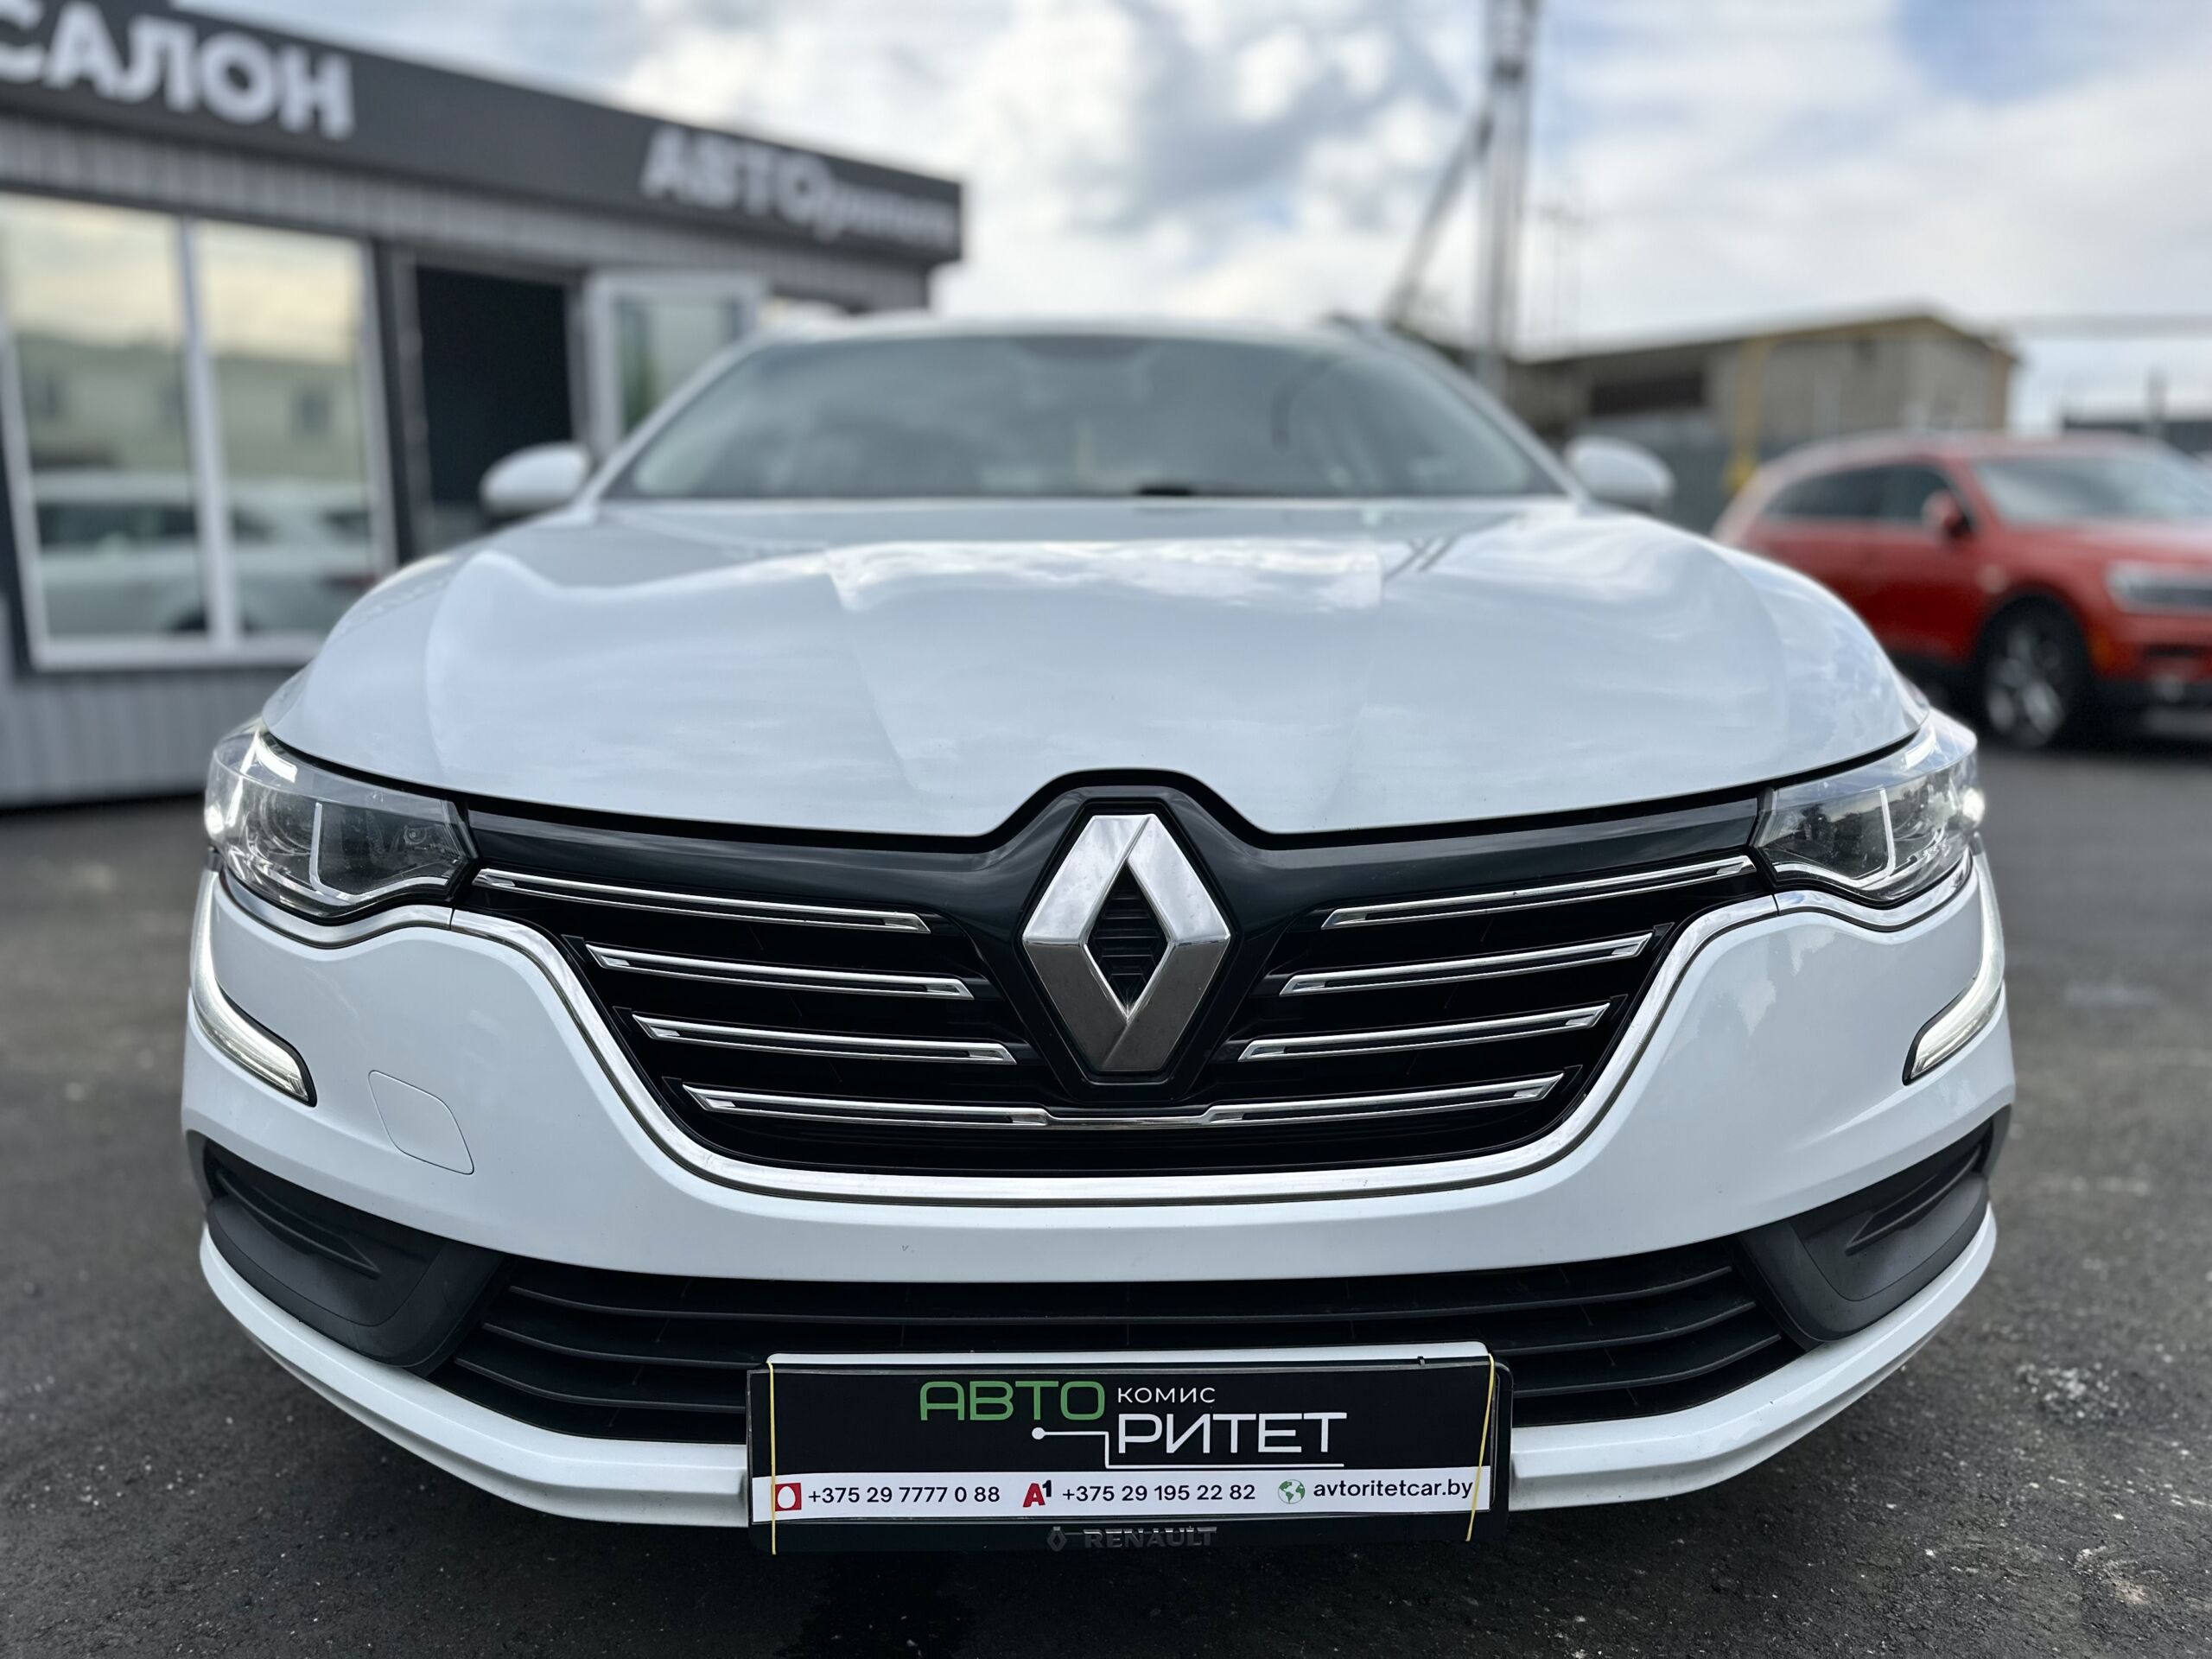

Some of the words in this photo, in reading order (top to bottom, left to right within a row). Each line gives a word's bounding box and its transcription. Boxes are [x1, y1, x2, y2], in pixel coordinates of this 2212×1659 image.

[919, 1381, 1104, 1421] АВТО
[1118, 1388, 1215, 1402] КОМИС
[1119, 1413, 1347, 1453] РИТЕТ
[809, 1487, 860, 1503] +375
[868, 1487, 892, 1503] 29
[899, 1487, 947, 1502] 7777
[955, 1487, 967, 1502] 0
[975, 1487, 1000, 1502] 88
[1063, 1486, 1114, 1501] +375
[1122, 1485, 1147, 1501] 29
[1154, 1485, 1190, 1500] 195
[1197, 1485, 1223, 1500] 22
[1230, 1484, 1255, 1499] 82
[1313, 1479, 1472, 1498] avtoritetcar.by
[1083, 1527, 1217, 1548] RENAULT
